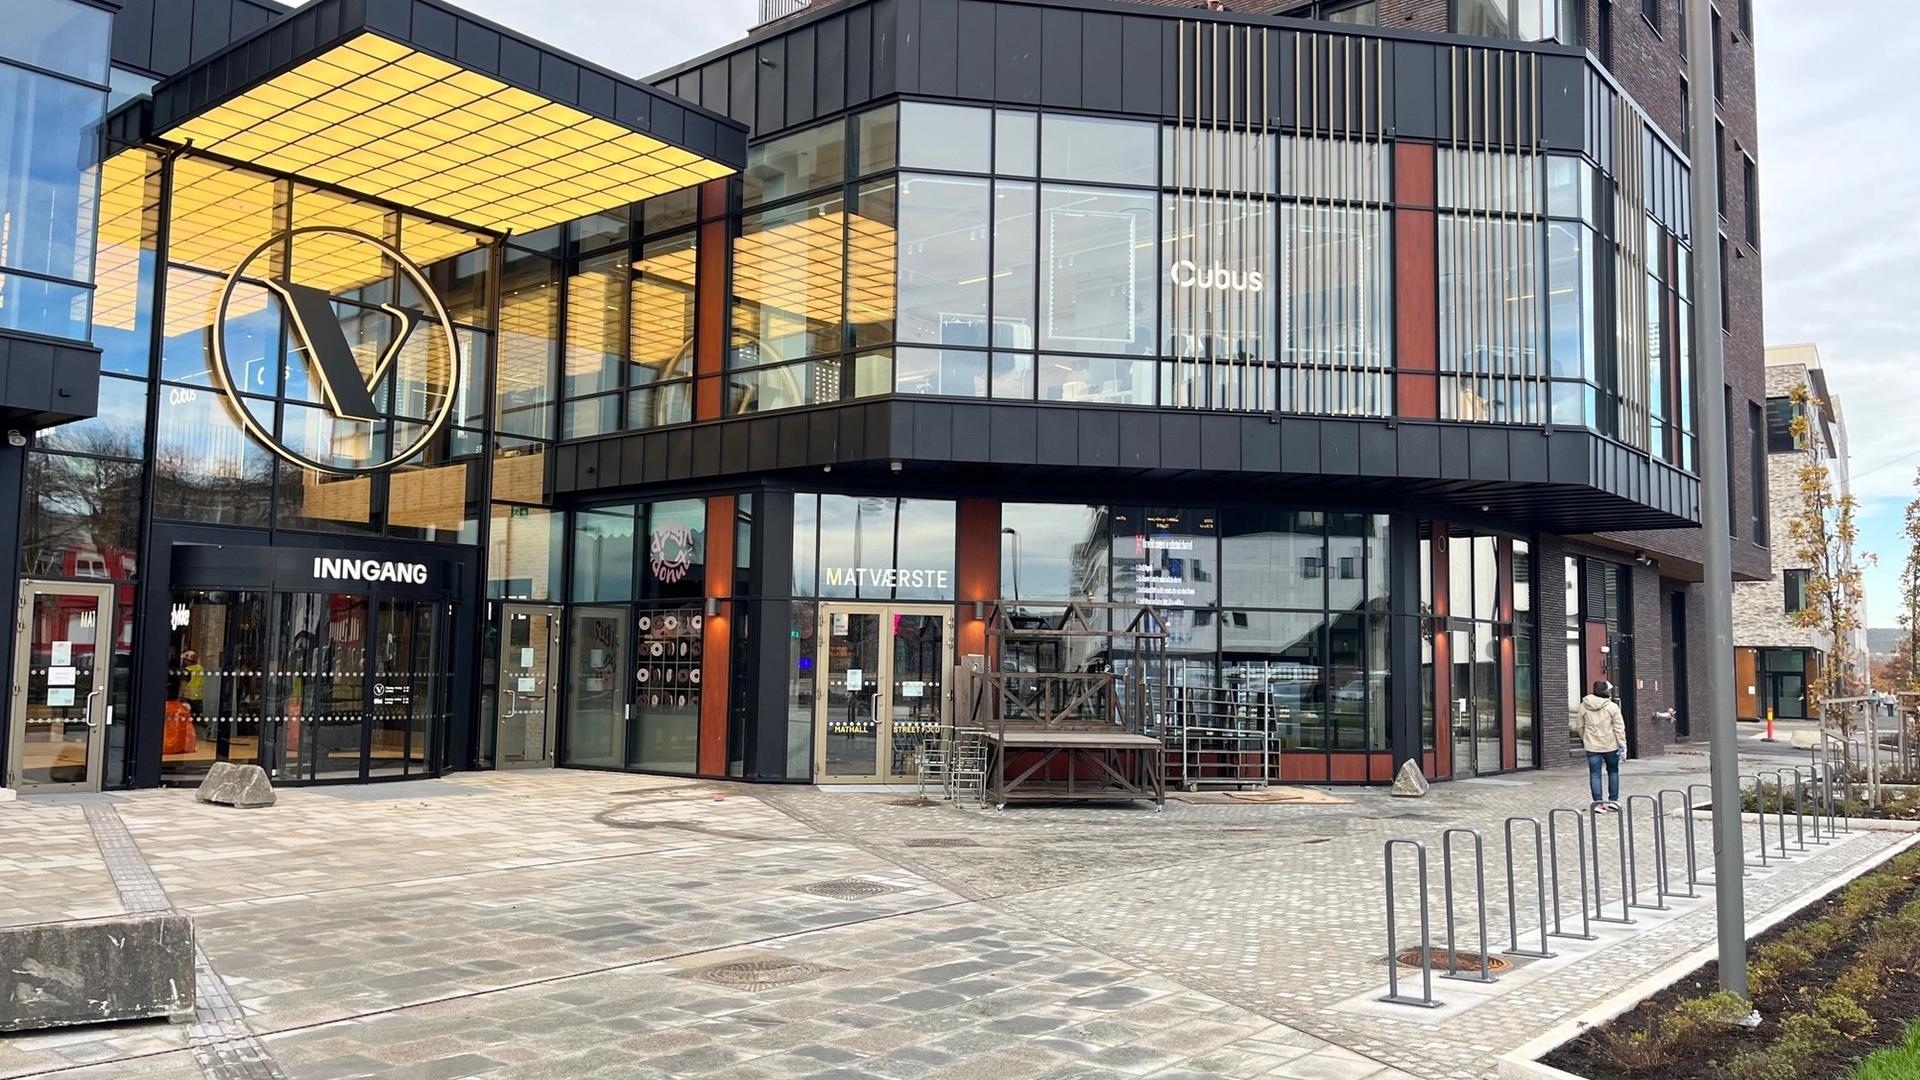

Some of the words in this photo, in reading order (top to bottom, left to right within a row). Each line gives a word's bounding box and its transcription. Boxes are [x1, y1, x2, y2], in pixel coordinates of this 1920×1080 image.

[1171, 260, 1263, 292] Cubus
[313, 557, 428, 585] INNGANG
[834, 725, 869, 734] MATHALL
[893, 726, 919, 734] STREET
